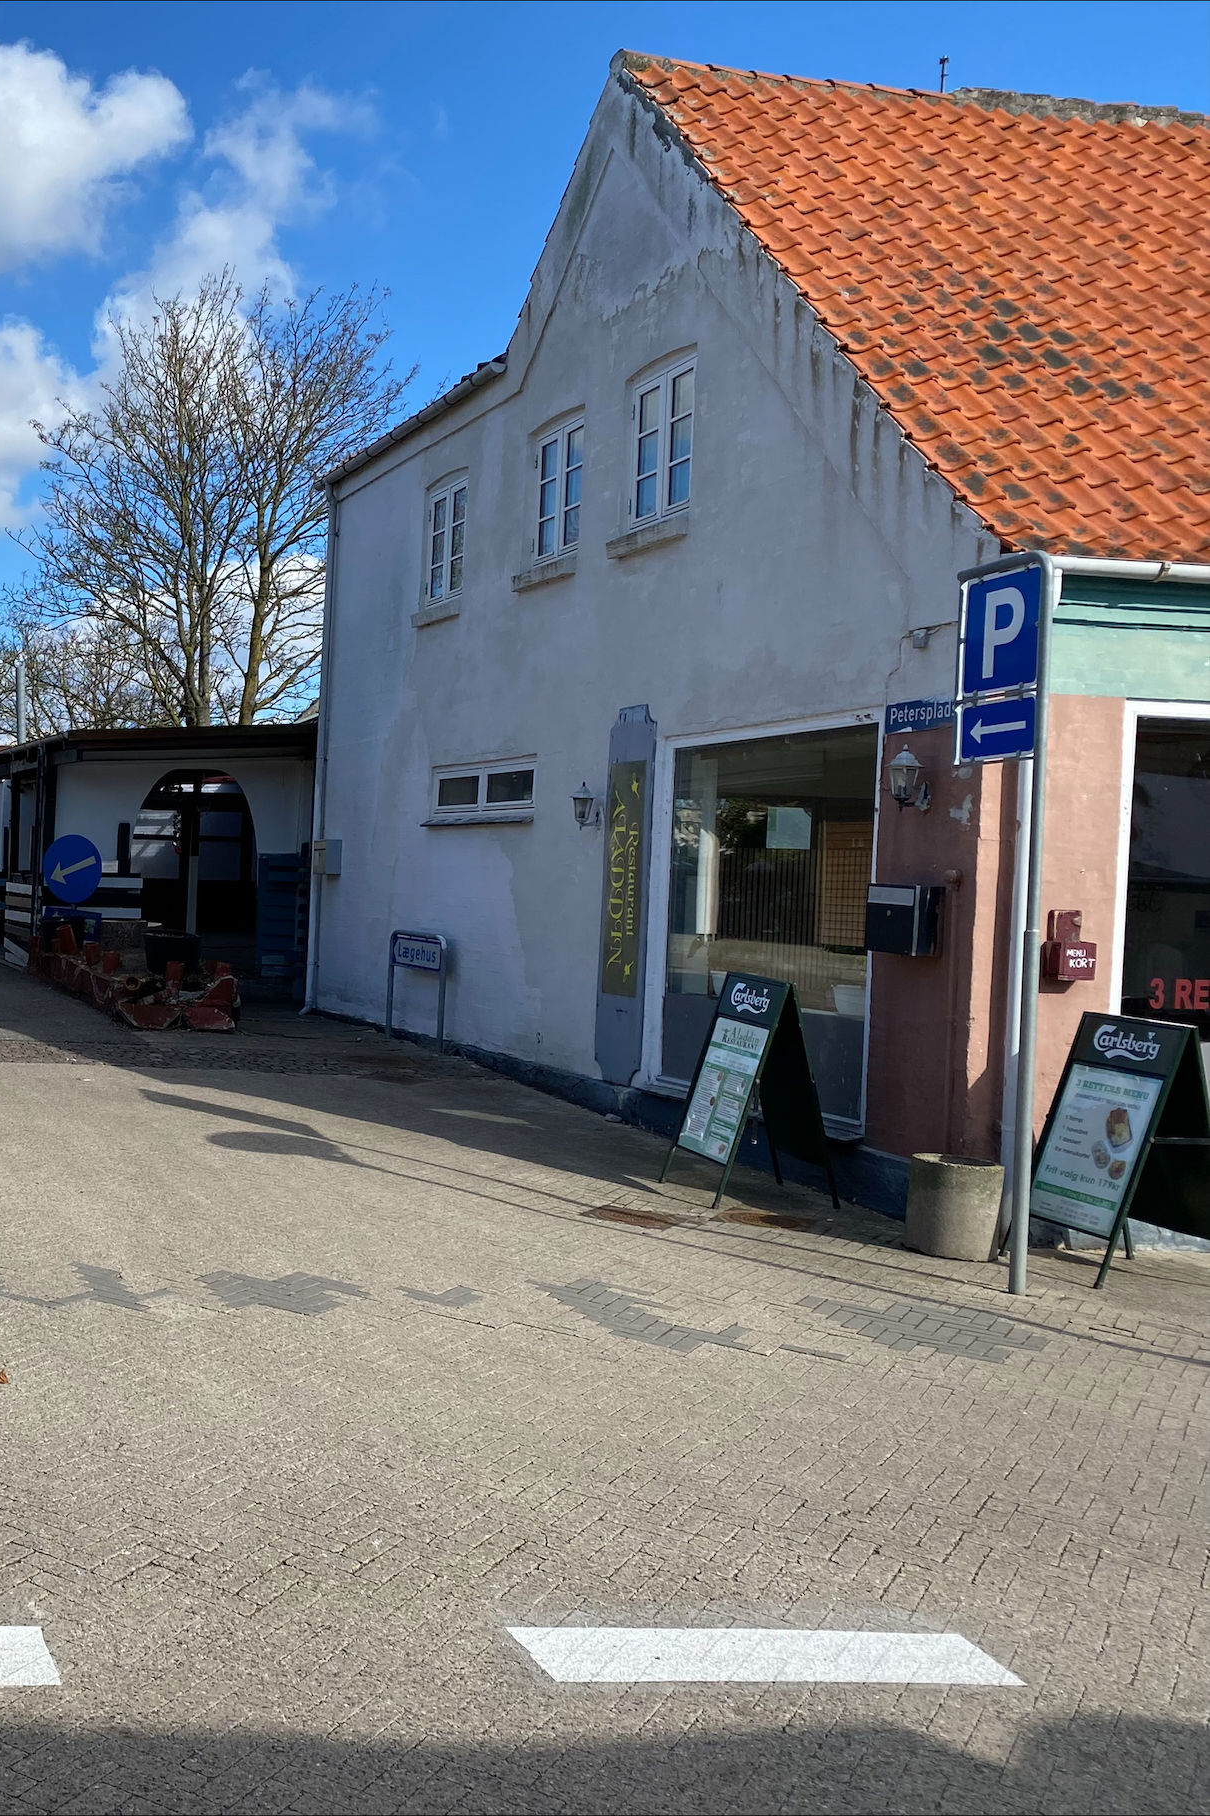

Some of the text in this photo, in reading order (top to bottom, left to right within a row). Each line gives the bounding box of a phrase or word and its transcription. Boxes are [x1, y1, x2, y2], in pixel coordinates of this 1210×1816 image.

[981, 586, 1026, 680] P
[606, 790, 627, 969] ALADDIN
[398, 941, 437, 963] Lægehus
[1069, 957, 1096, 968] KORT
[731, 982, 770, 1013] Carlsberg
[1149, 977, 1165, 1010] 3
[1093, 1024, 1161, 1061] Carlsberg
